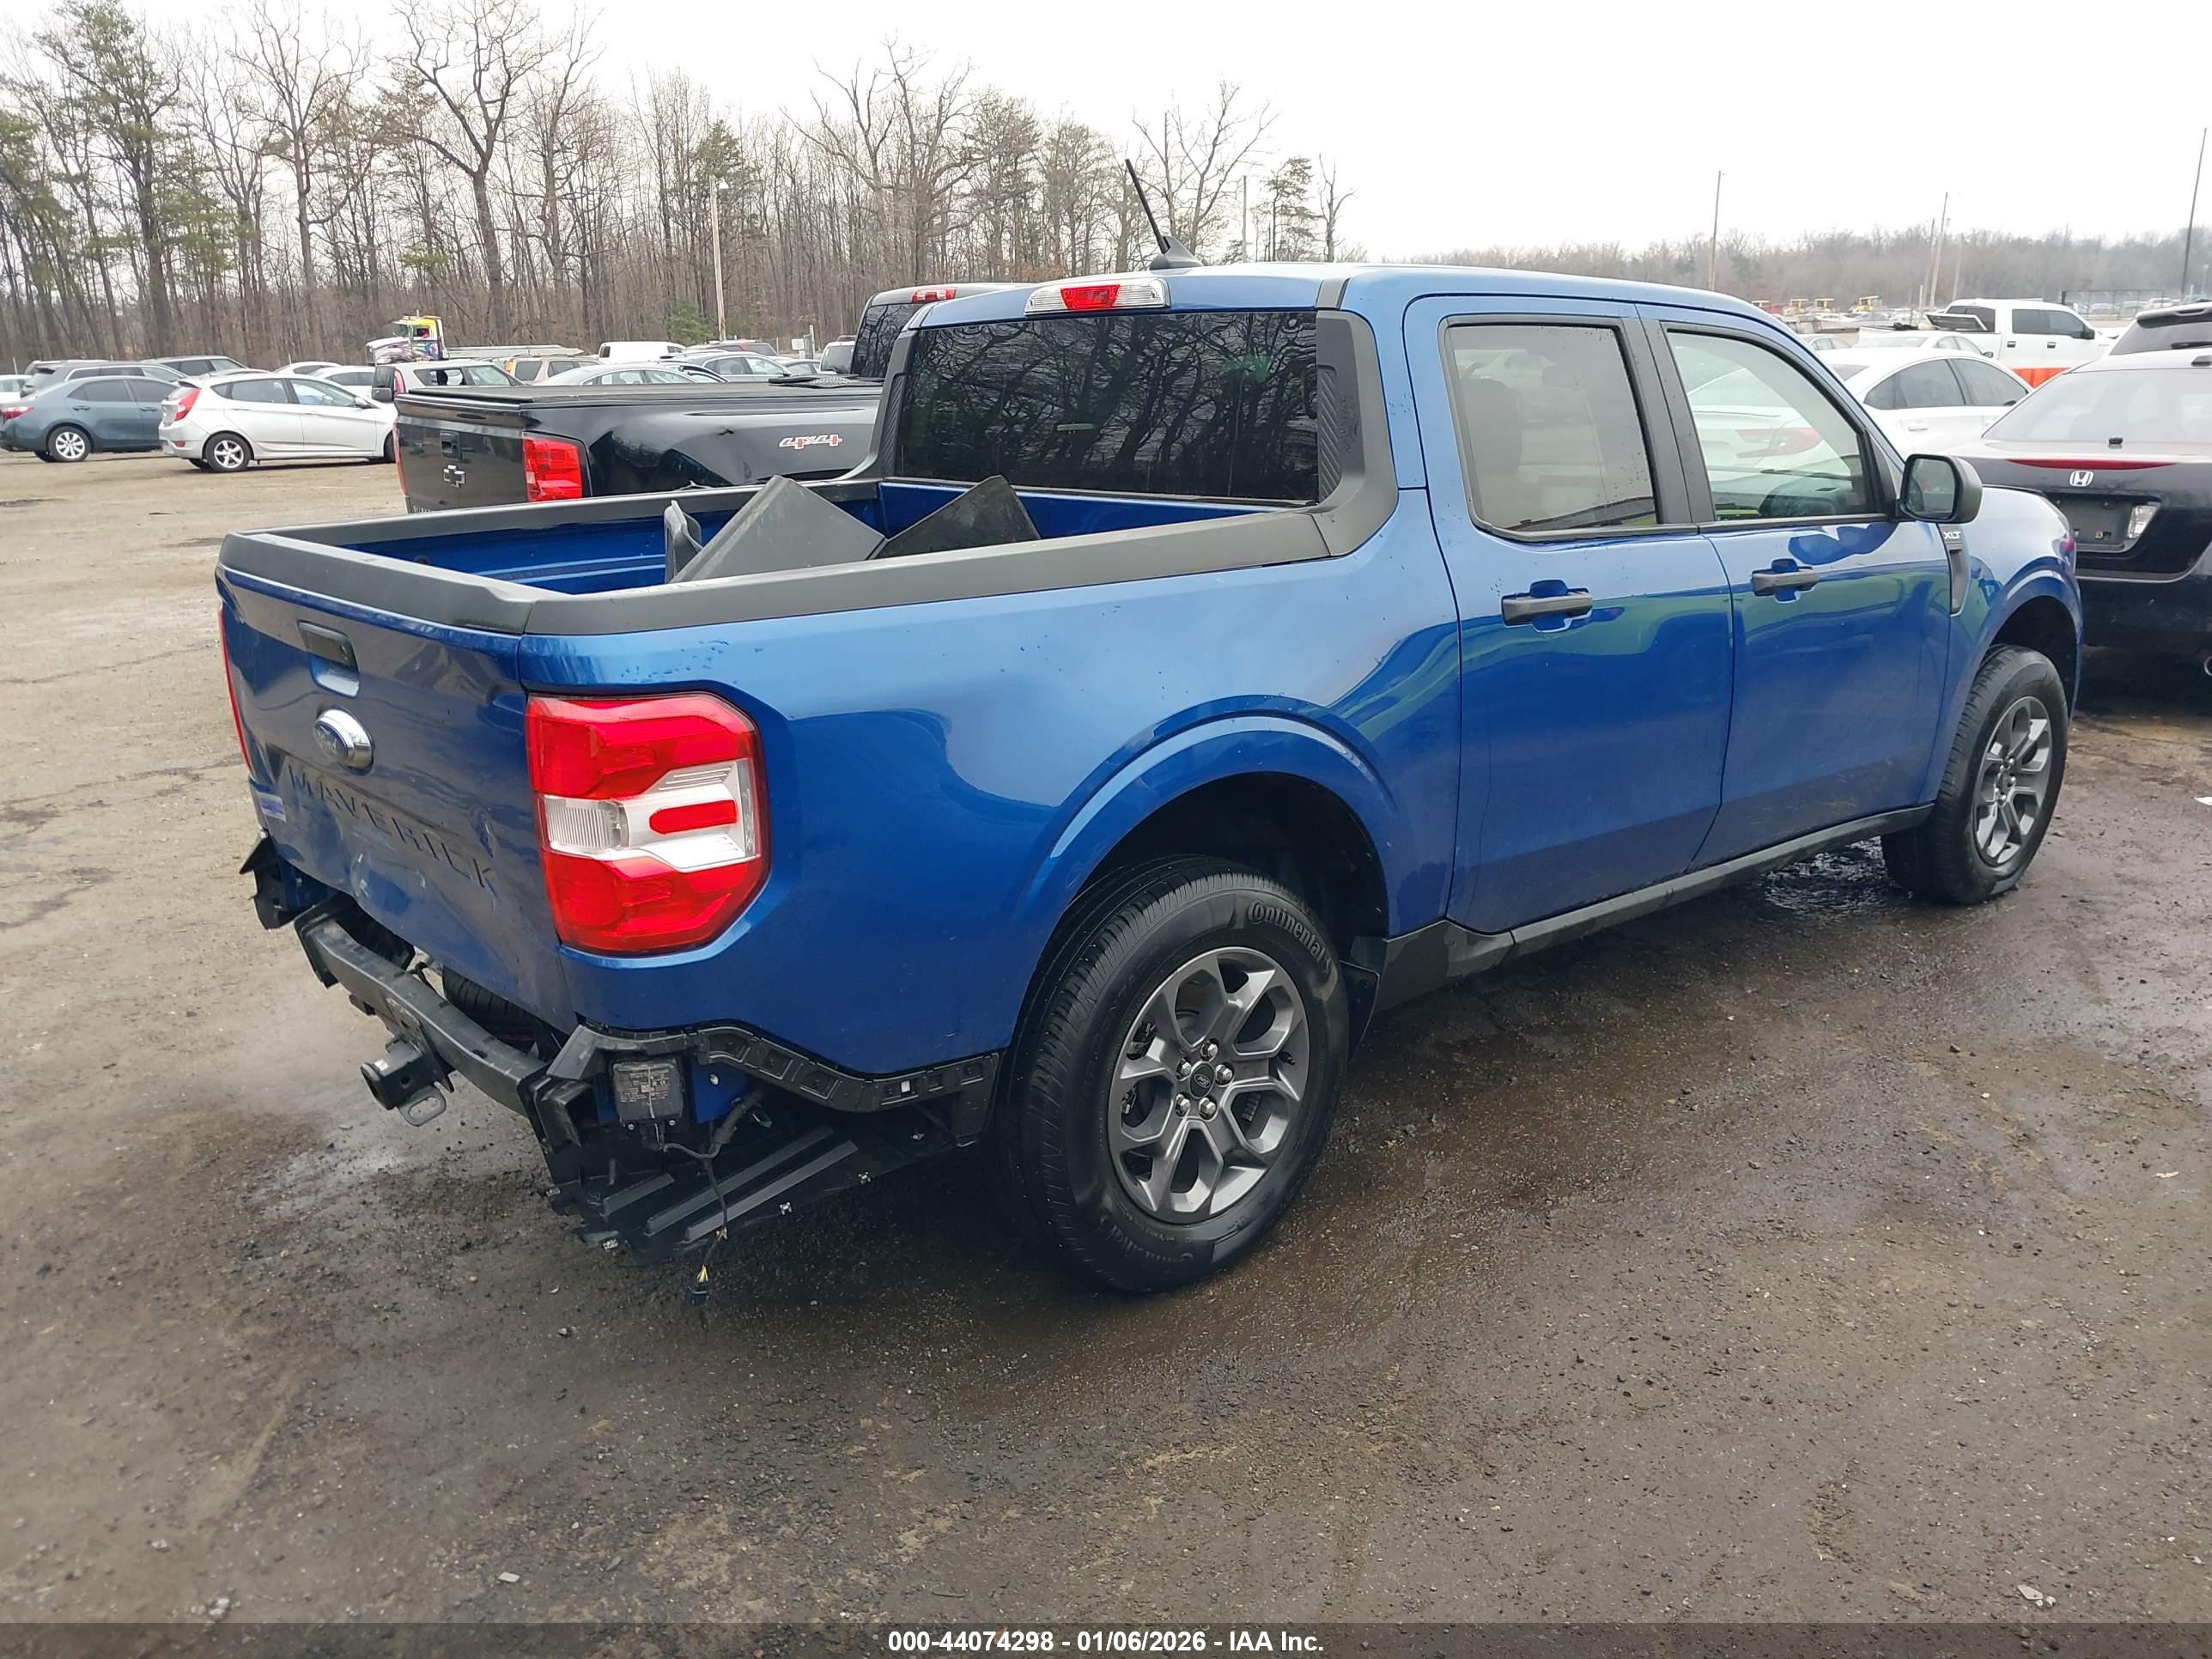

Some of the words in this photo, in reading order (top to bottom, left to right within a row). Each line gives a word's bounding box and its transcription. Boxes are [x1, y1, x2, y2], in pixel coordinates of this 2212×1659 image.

[1943, 531, 1961, 539] XLT
[288, 764, 499, 901] MAVERICK
[1248, 899, 1327, 963] Continental
